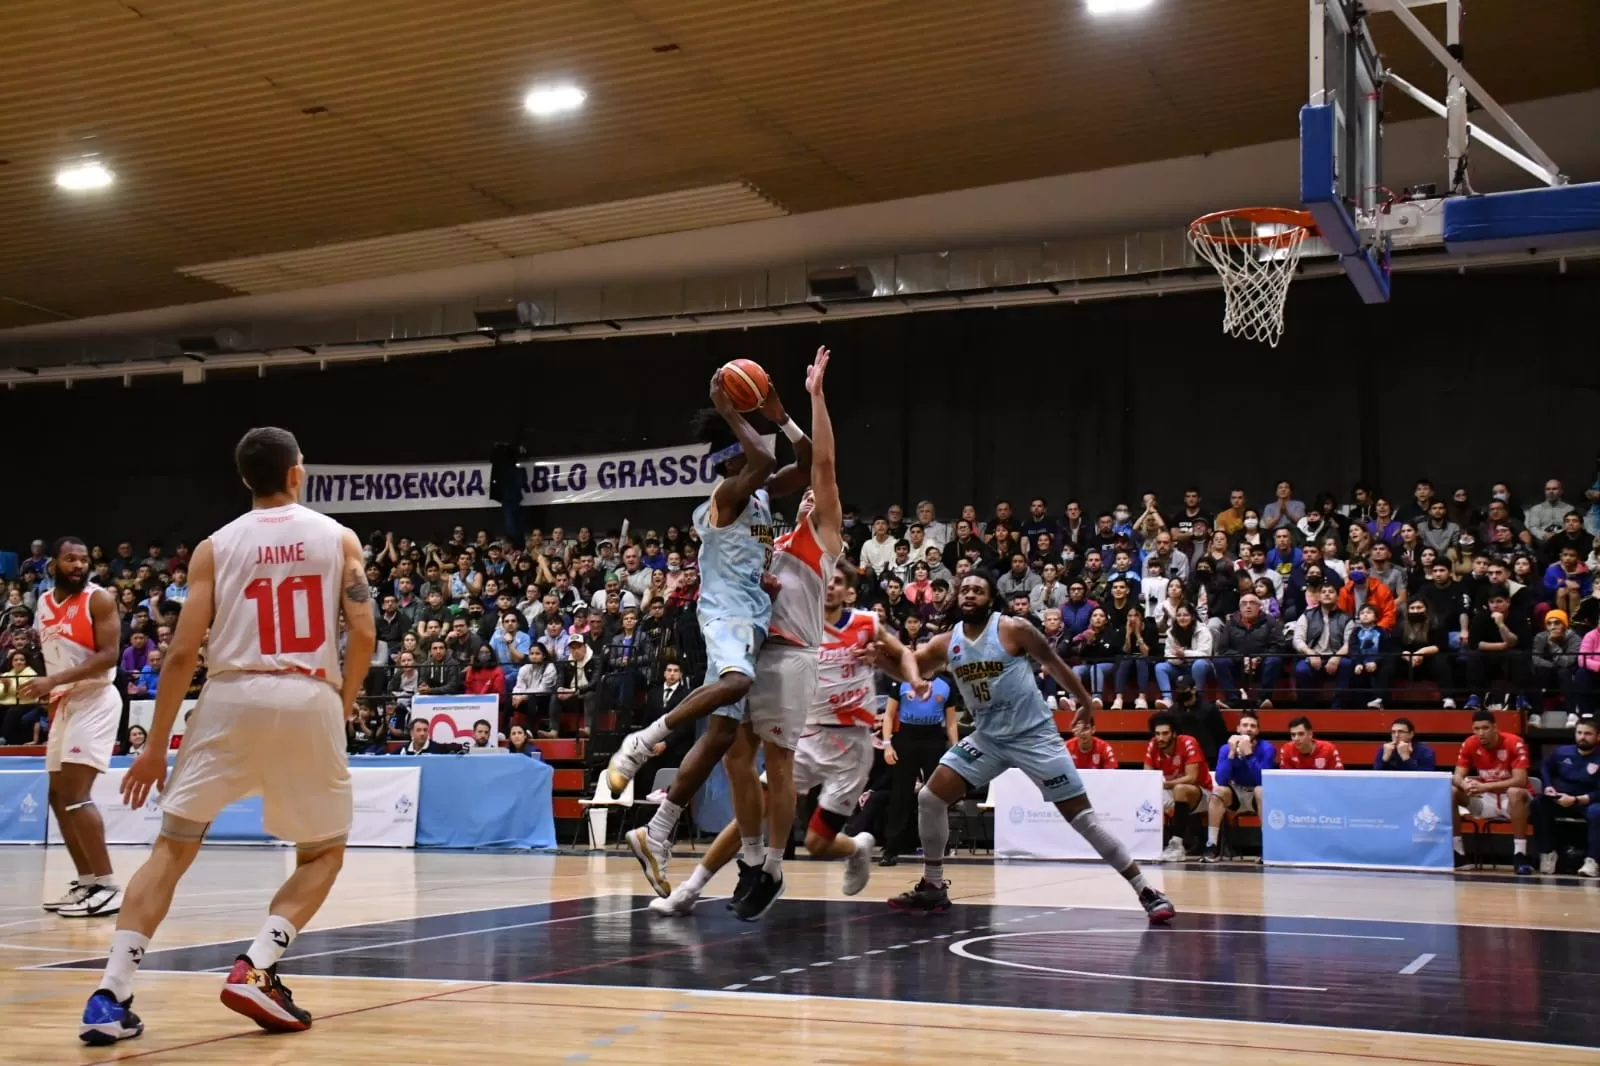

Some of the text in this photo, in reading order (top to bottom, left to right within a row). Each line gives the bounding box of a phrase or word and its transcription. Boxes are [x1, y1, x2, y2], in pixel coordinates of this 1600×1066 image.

[306, 454, 717, 502] INTENDENCIA ABLO GRASSO
[256, 542, 305, 565] JAIME
[244, 575, 326, 655] 10
[840, 663, 856, 679] 31
[1287, 814, 1317, 824] Santa
[1318, 815, 1342, 825] Cruz
